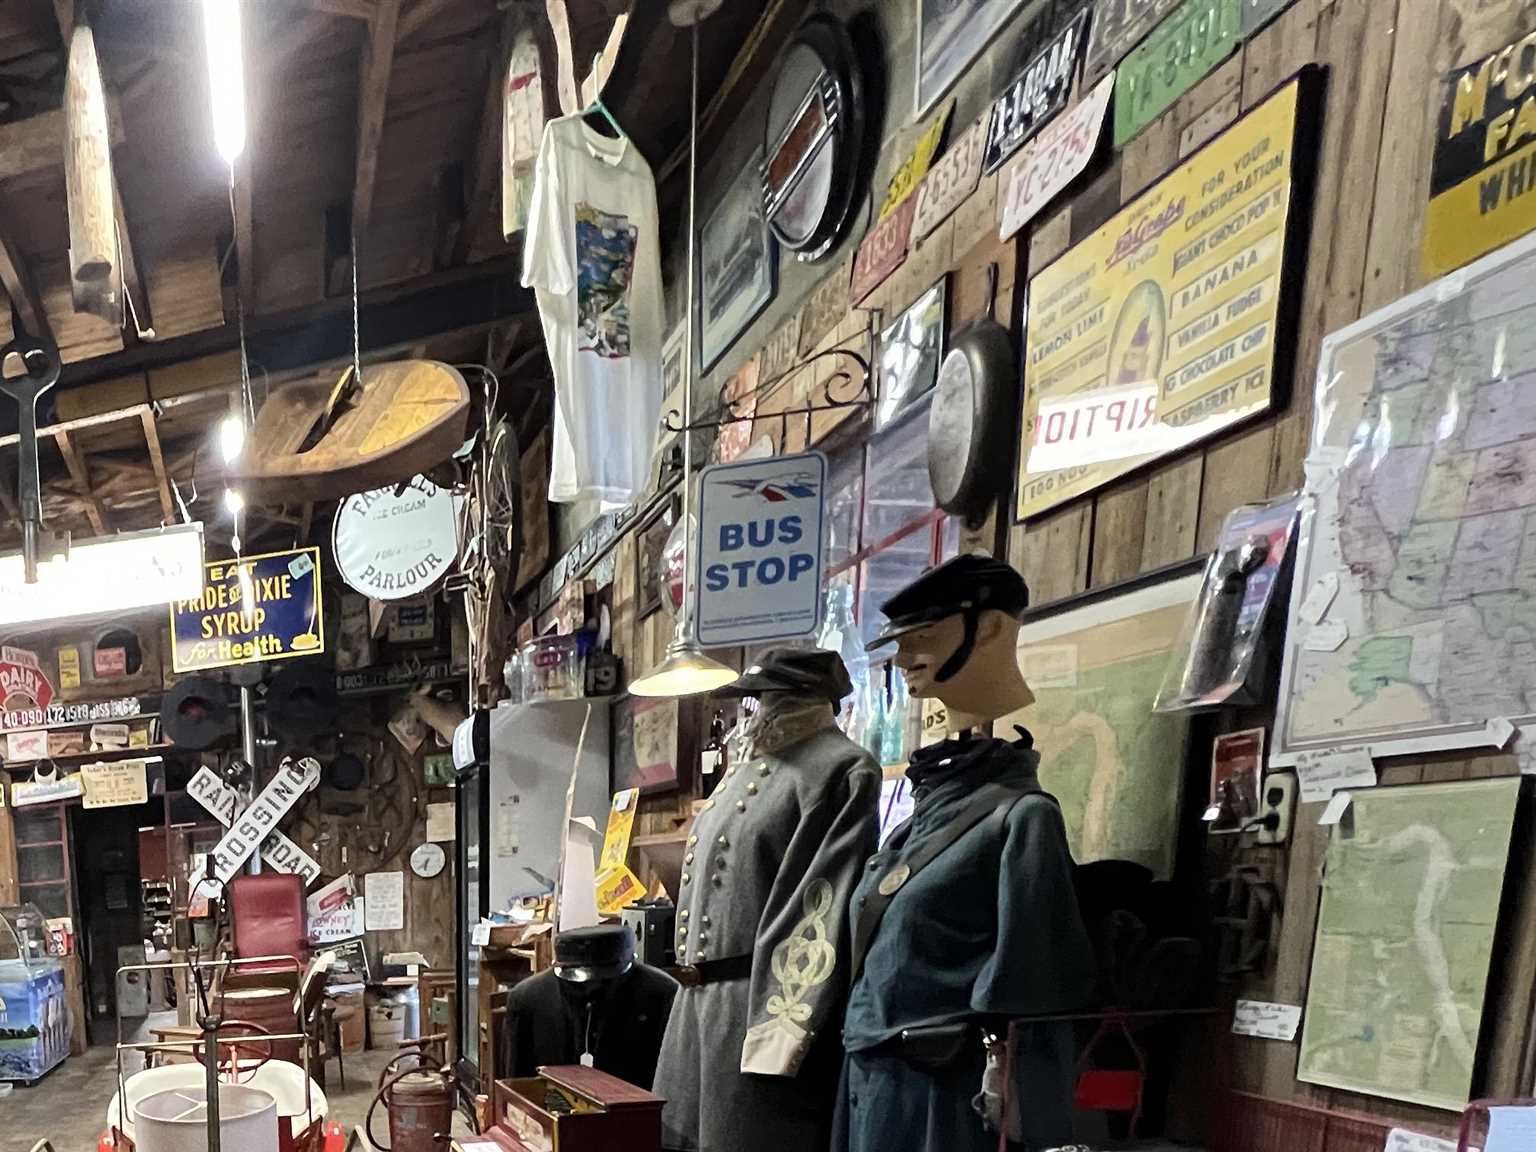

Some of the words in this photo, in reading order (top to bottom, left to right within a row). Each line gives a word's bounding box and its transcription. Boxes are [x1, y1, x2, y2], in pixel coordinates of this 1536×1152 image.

[1485, 95, 1536, 162] FA
[1184, 150, 1284, 232] CONSIDERATION
[1201, 170, 1225, 197] FOR
[1479, 150, 1536, 216] WHI
[1181, 250, 1258, 309] BANANA
[1033, 331, 1073, 366] LEMON
[1076, 305, 1105, 336] LIME
[1180, 342, 1236, 387] CHOCOLATE
[1172, 381, 1239, 426] ASPBERRY
[719, 515, 804, 552] BUS
[211, 562, 257, 582] EAT
[359, 551, 443, 591] PARLOUR
[705, 553, 814, 593] STOP
[177, 587, 228, 615] PRIDE
[201, 608, 266, 640] SYRUP
[217, 634, 283, 660] Health
[0, 666, 42, 691] DAIRY
